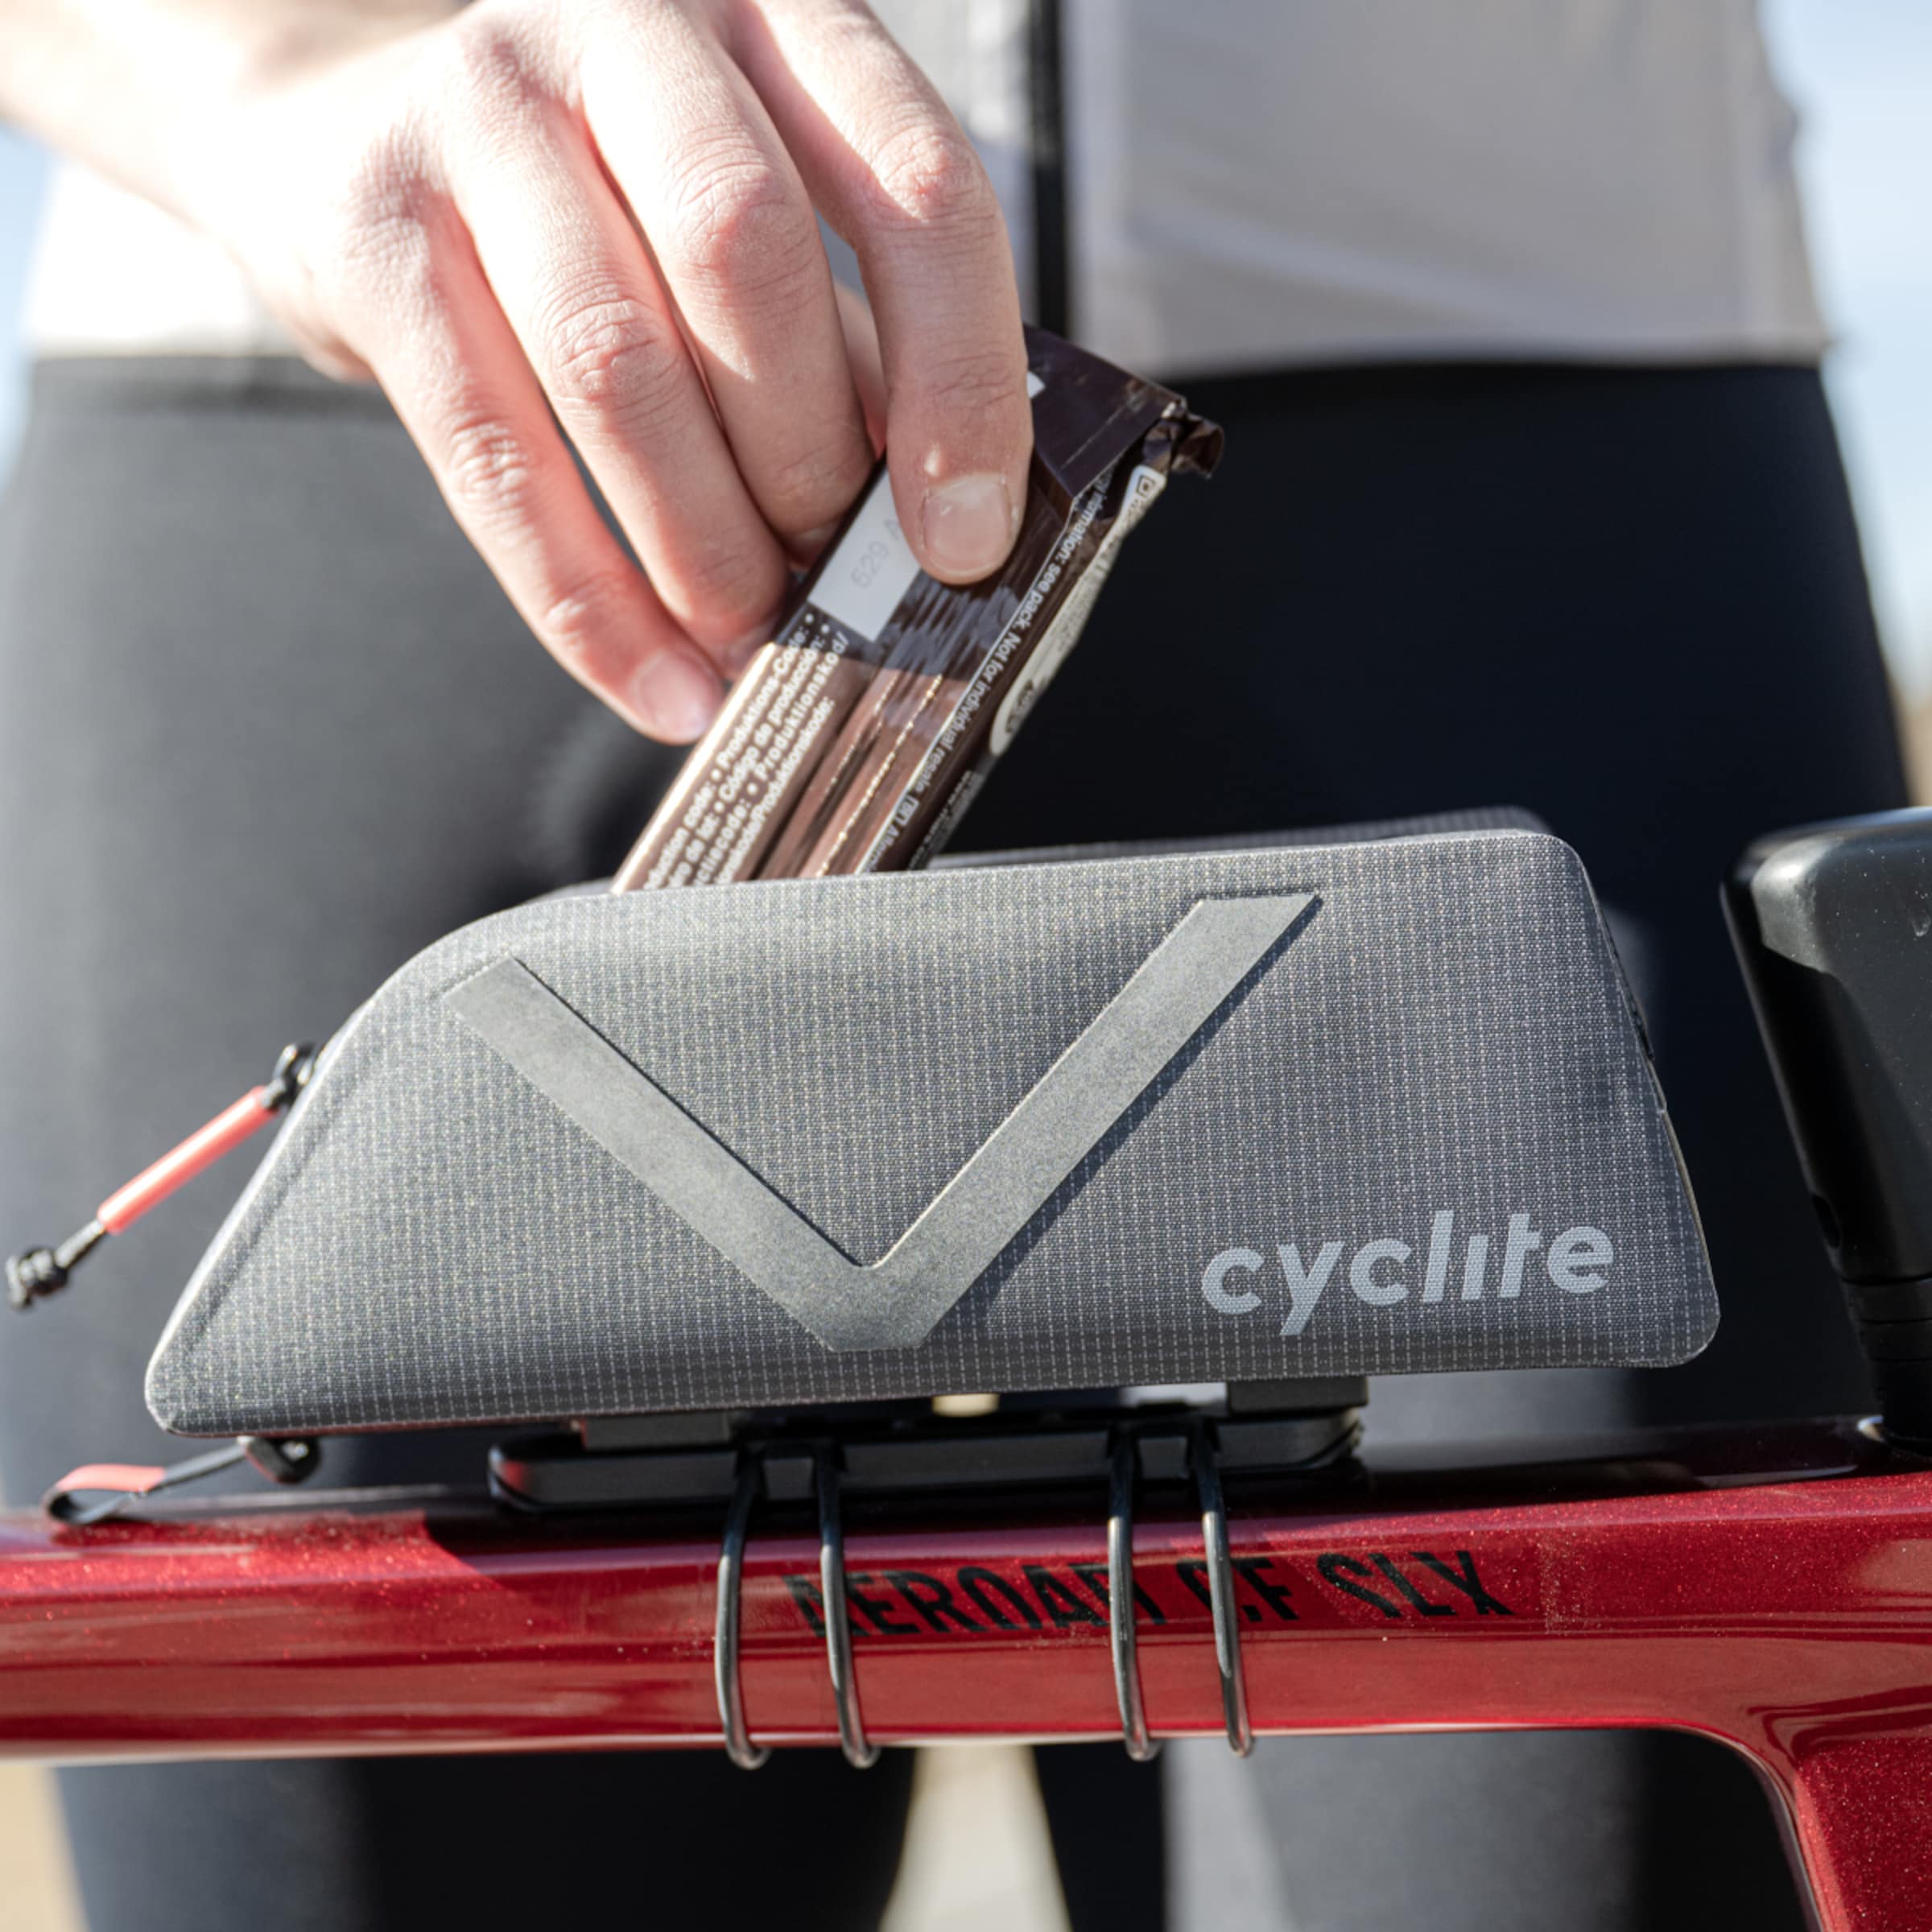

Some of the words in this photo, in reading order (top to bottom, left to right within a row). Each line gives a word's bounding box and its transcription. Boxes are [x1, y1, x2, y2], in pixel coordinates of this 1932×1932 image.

[1038, 564, 1061, 590] see
[994, 632, 1021, 661] Not
[980, 659, 1004, 683] for
[751, 722, 774, 746] de
[939, 681, 990, 749] individual
[681, 780, 717, 828] code:
[1201, 1210, 1613, 1335] cyclite
[1316, 1550, 1515, 1618] SLX
